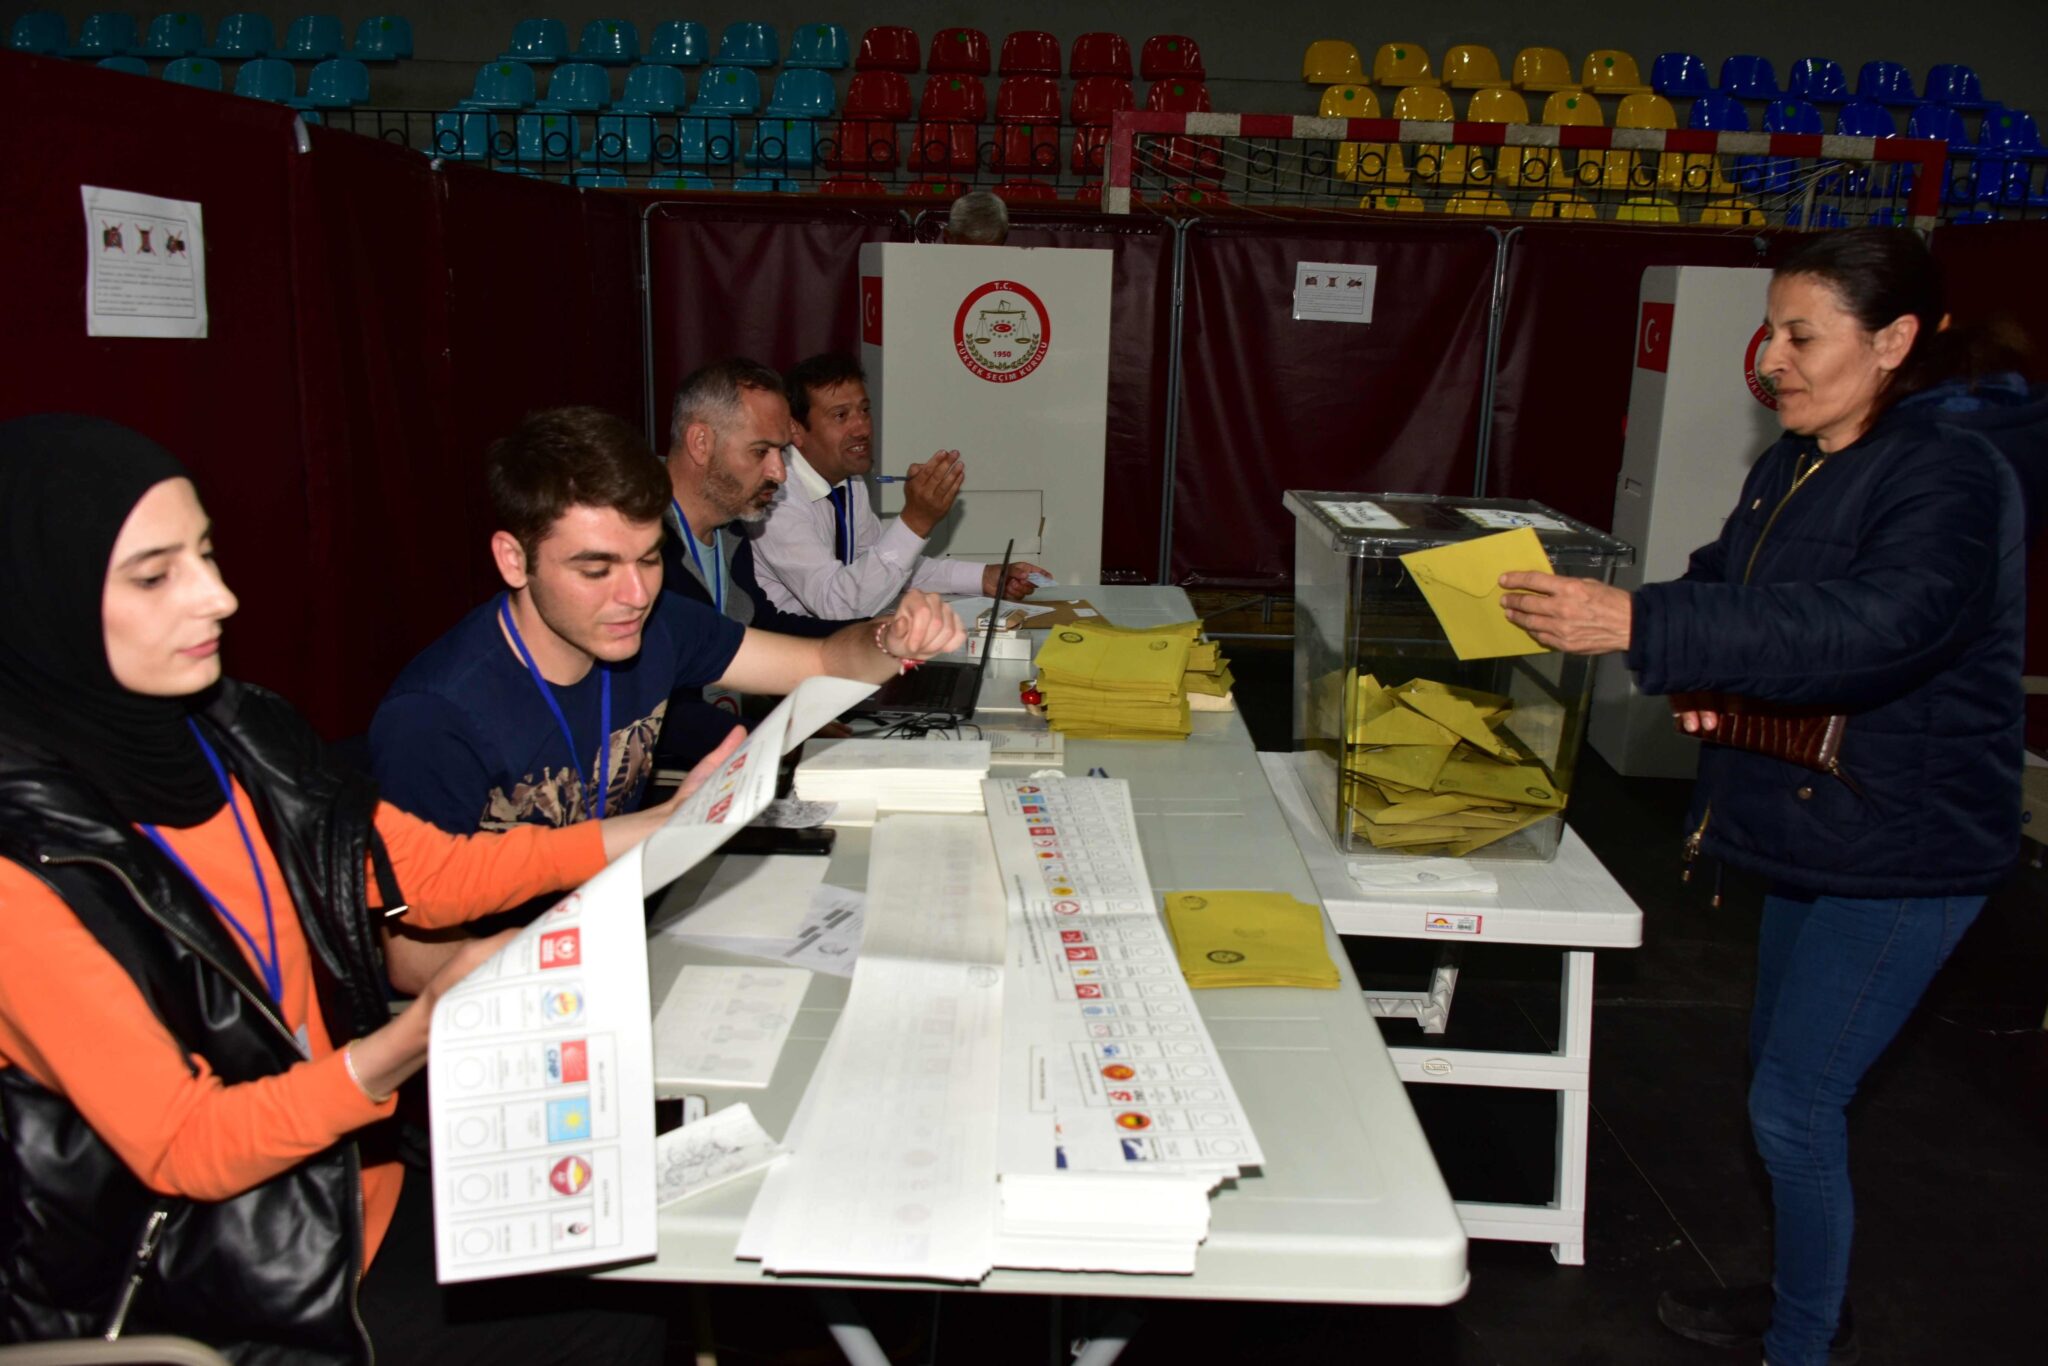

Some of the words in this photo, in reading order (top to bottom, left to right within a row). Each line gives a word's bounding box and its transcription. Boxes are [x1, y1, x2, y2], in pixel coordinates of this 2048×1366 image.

[994, 282, 1012, 290] T.C.
[957, 341, 985, 375] YÜKSEK
[986, 372, 1017, 382] SEÇİM
[1020, 342, 1047, 376] KURULU
